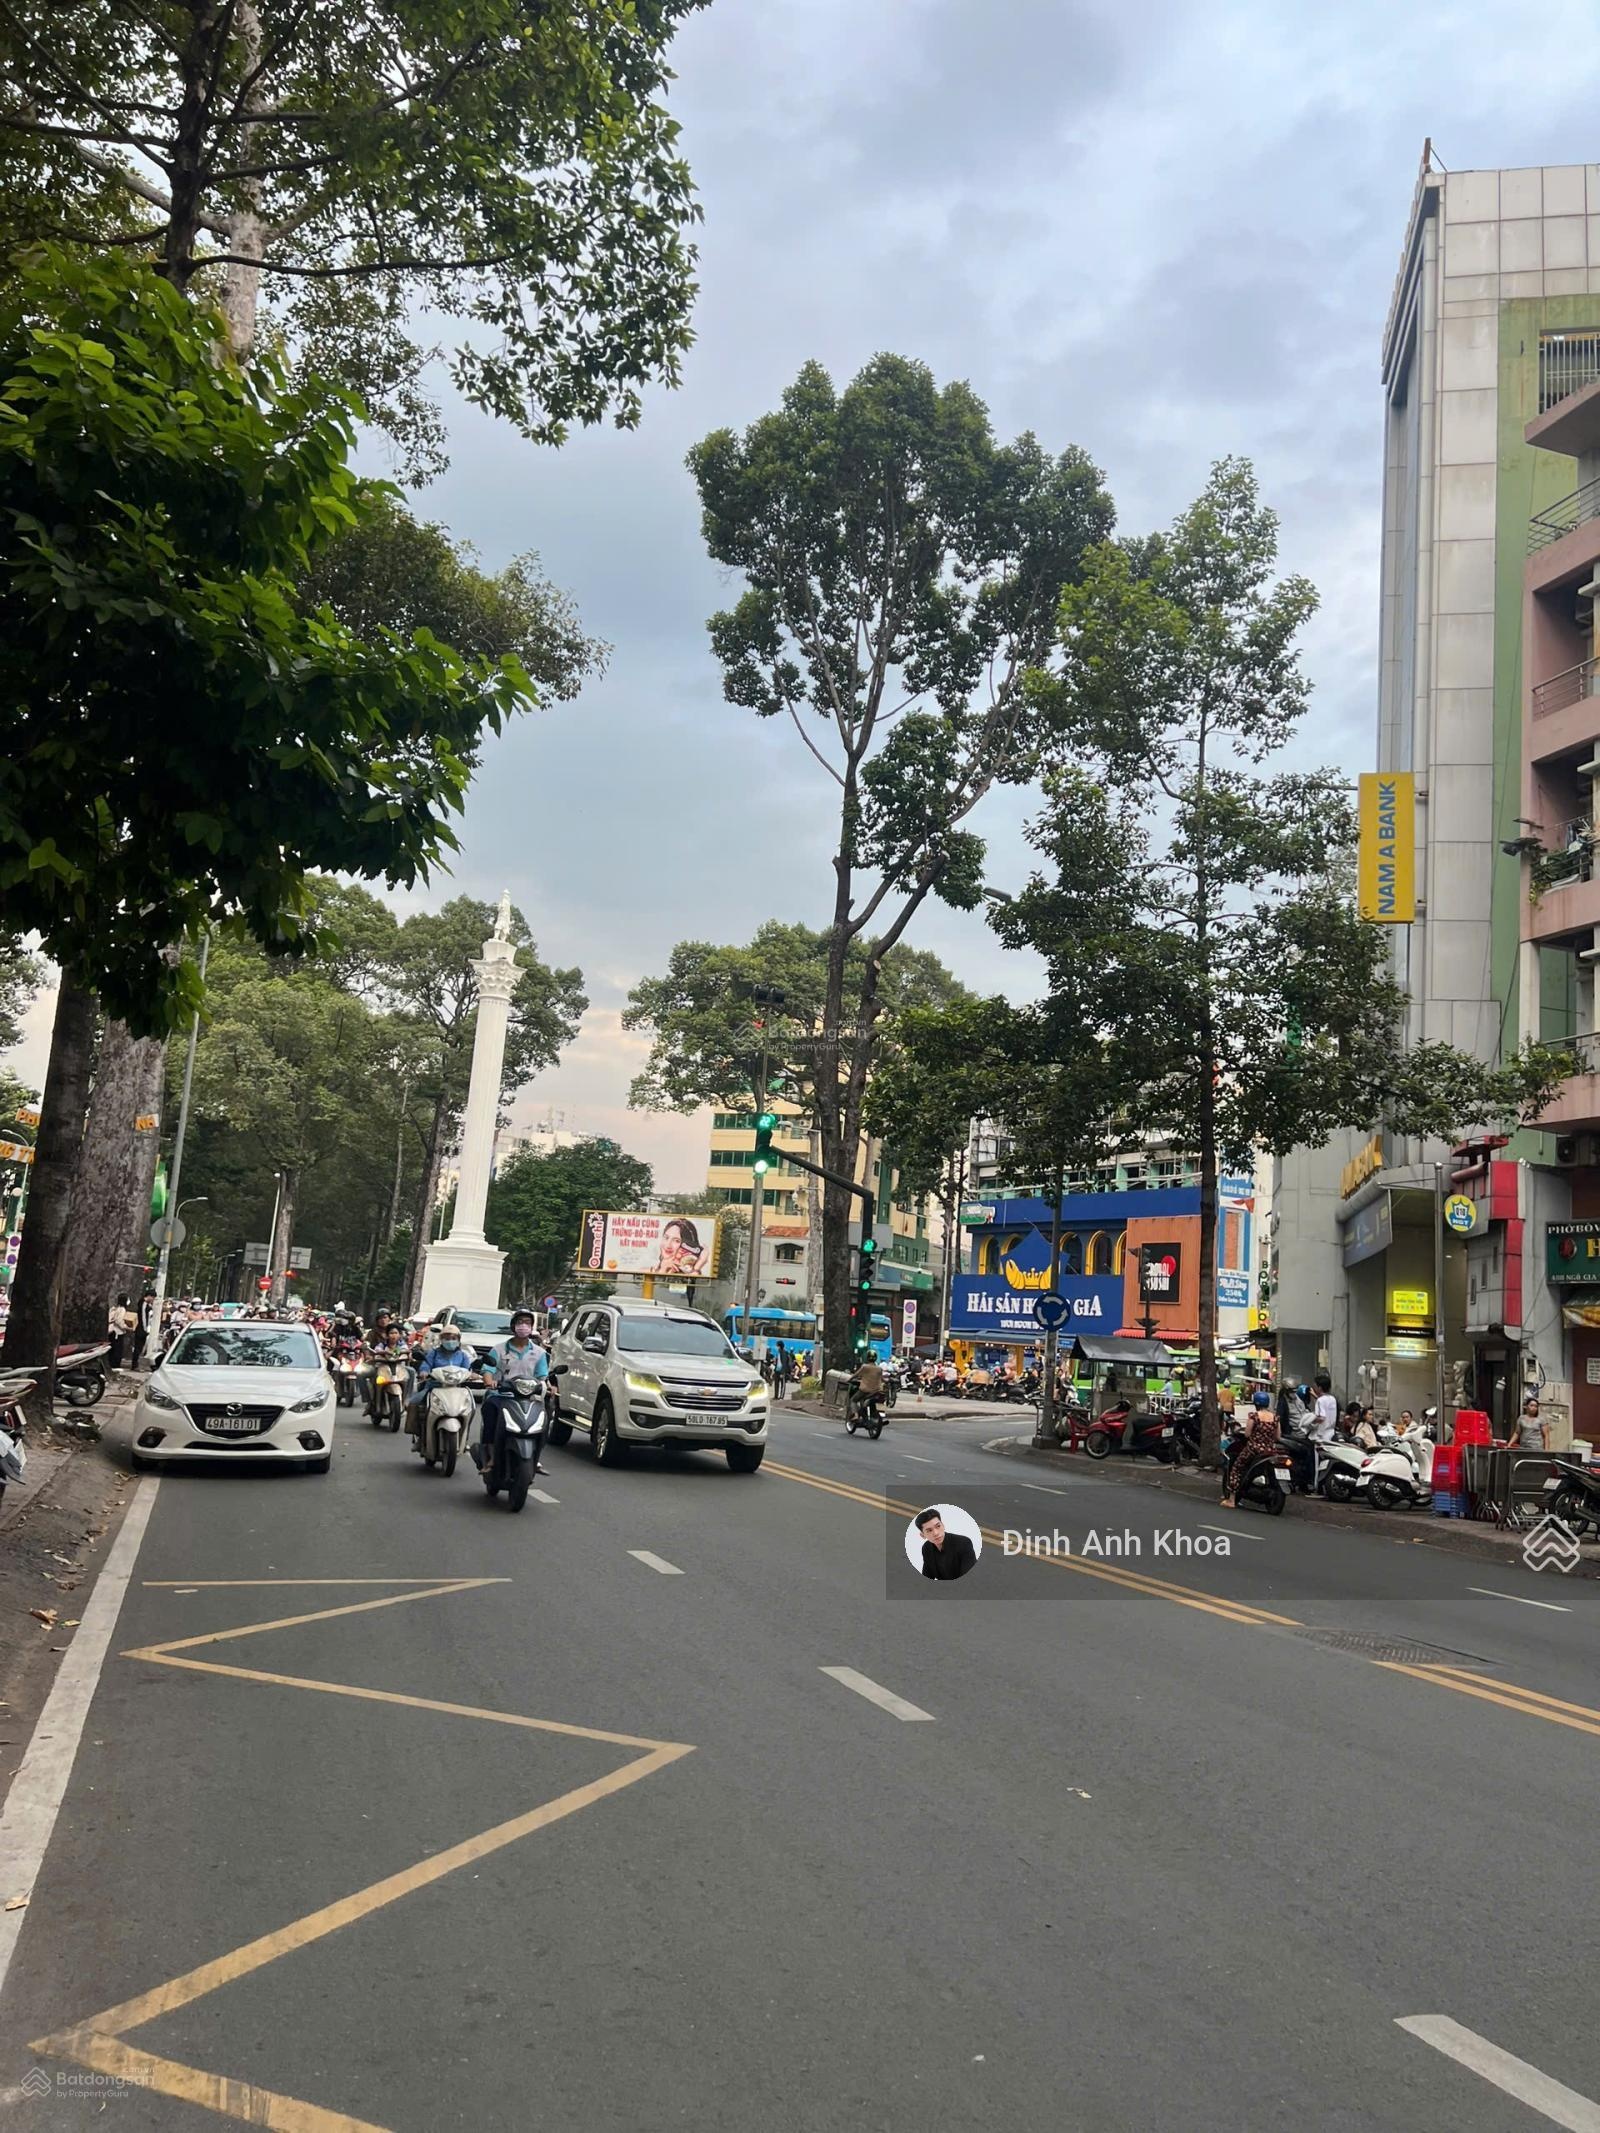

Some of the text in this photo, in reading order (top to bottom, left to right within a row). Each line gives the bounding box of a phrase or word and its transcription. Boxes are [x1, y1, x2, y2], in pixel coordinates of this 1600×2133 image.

[1378, 781, 1396, 914] NAM A BANK
[1073, 1295, 1102, 1316] GIA
